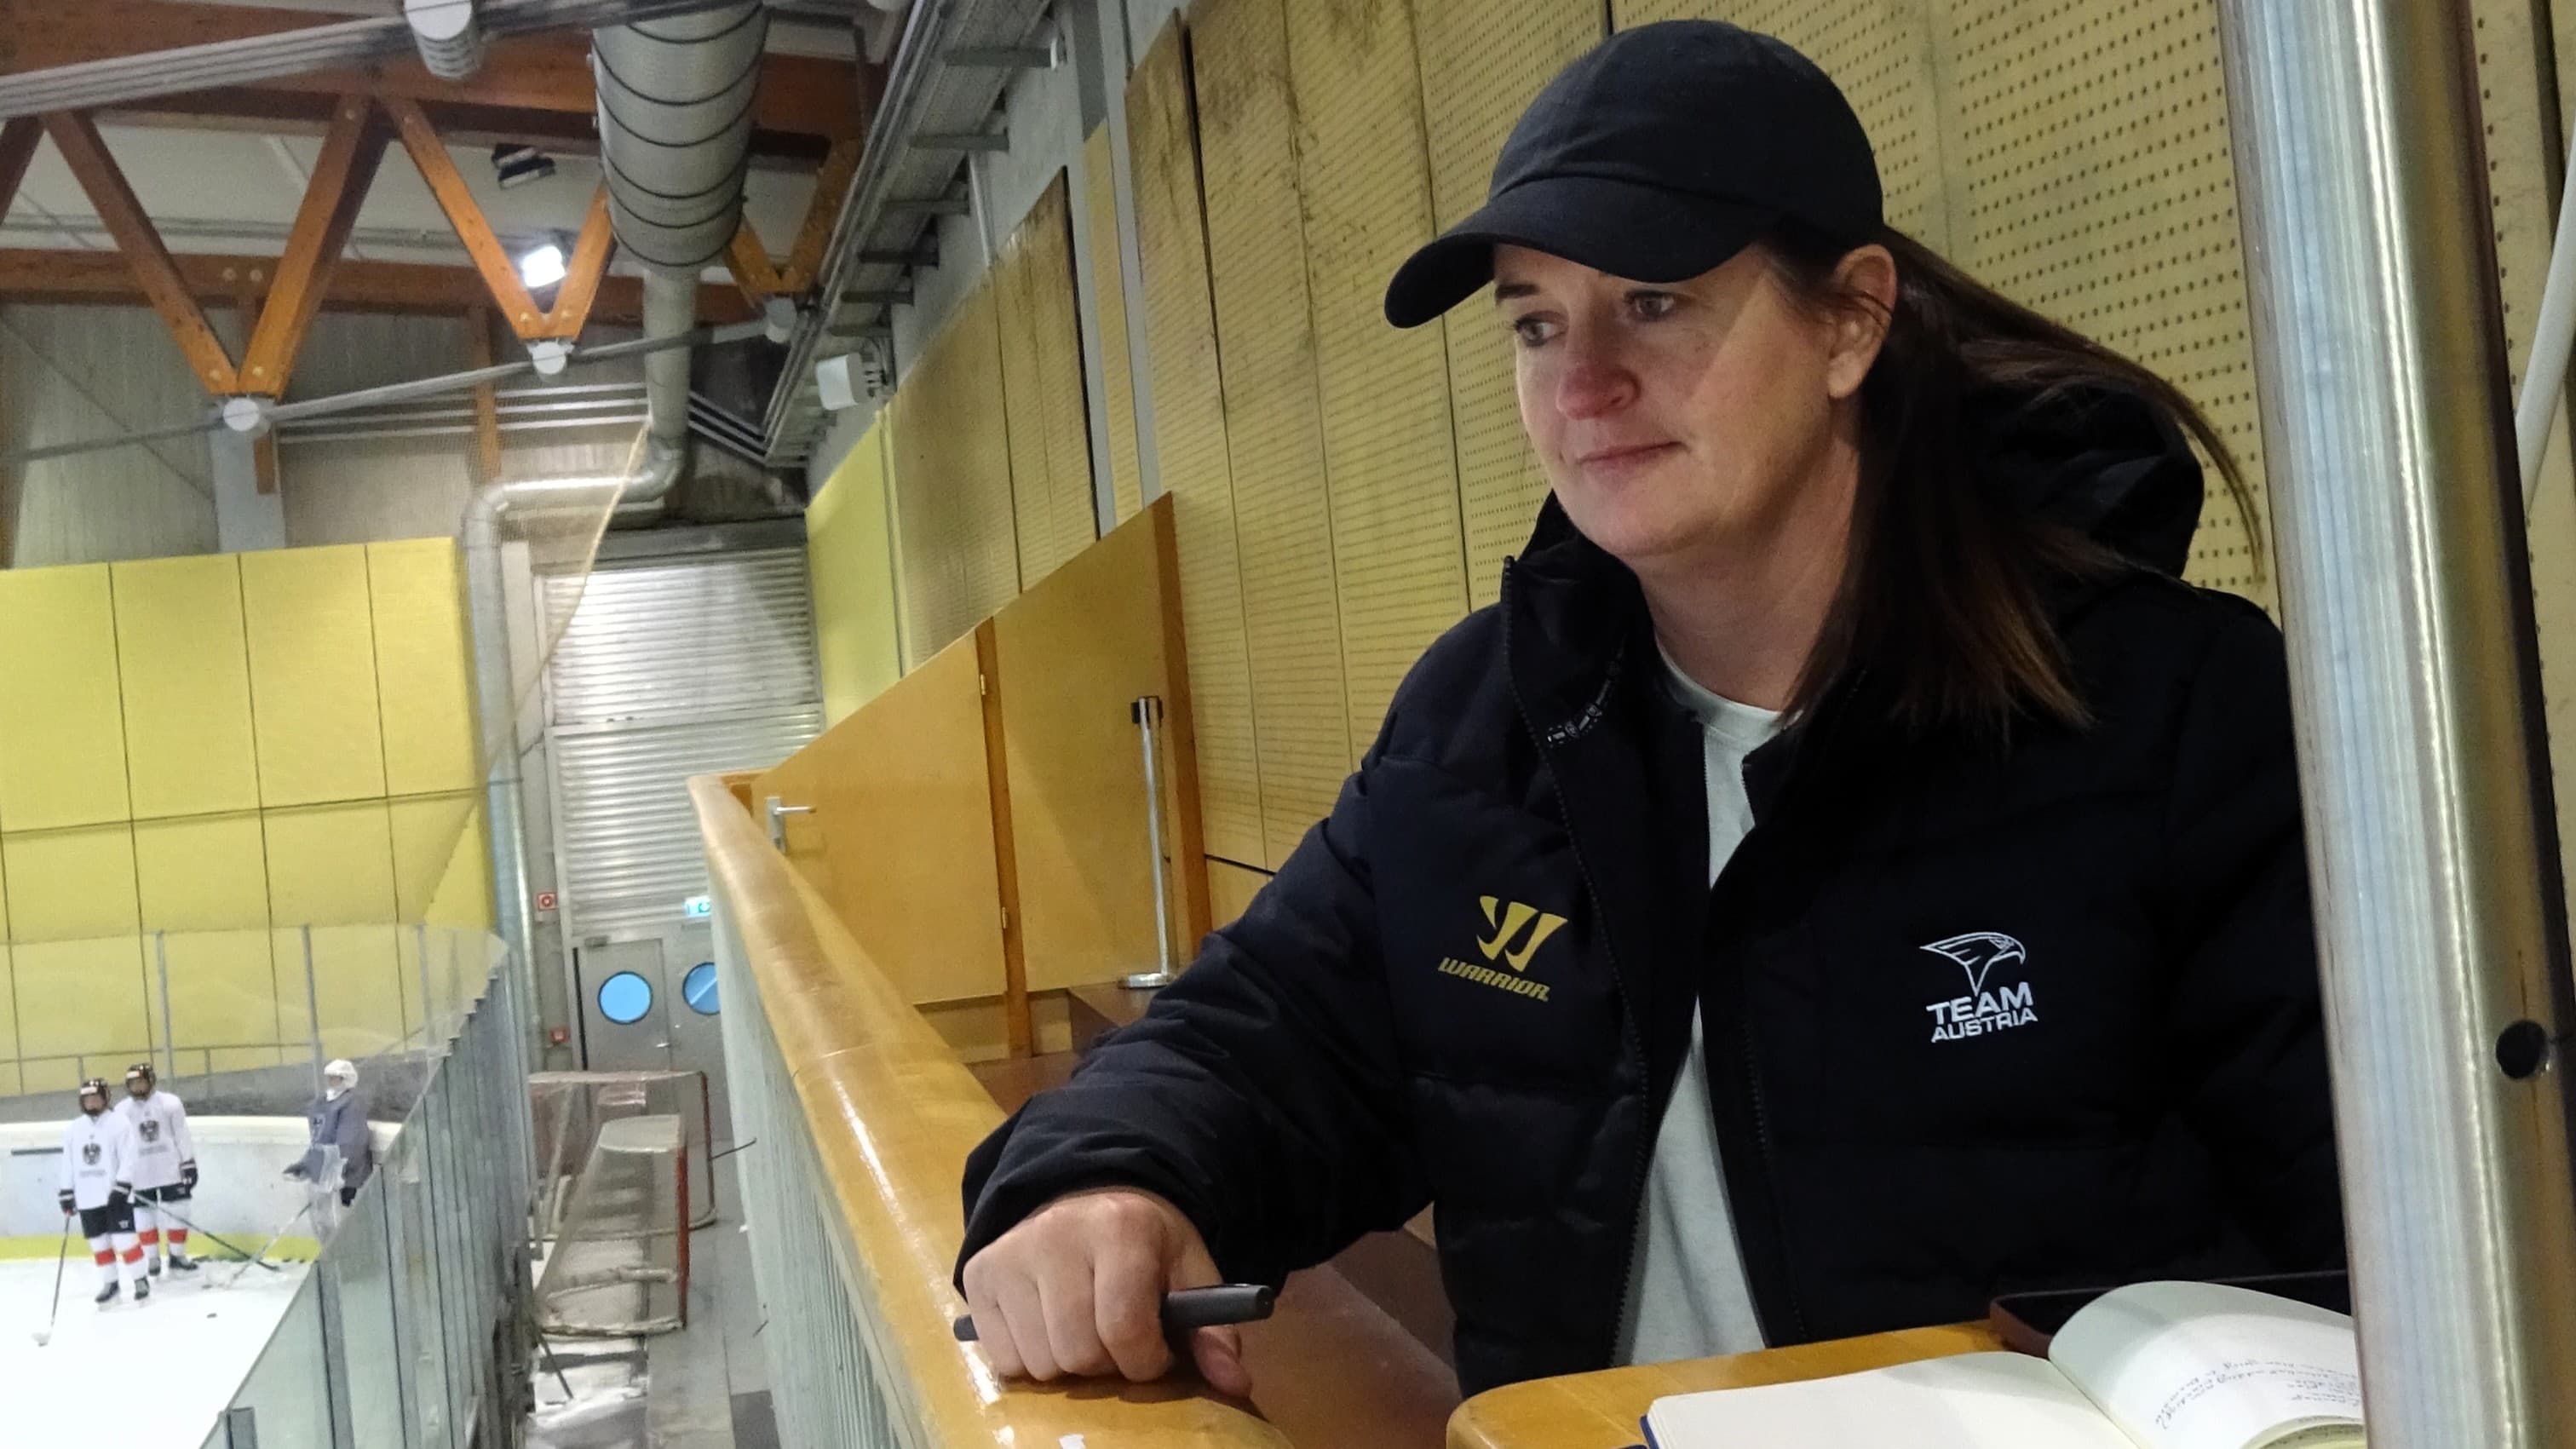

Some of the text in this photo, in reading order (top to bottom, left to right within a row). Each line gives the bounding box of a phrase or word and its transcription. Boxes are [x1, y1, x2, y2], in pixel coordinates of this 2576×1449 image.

[1437, 957, 1550, 1002] WARRIOR
[1926, 981, 2033, 1025] TEAM
[1931, 1007, 2038, 1043] AUSTRIA
